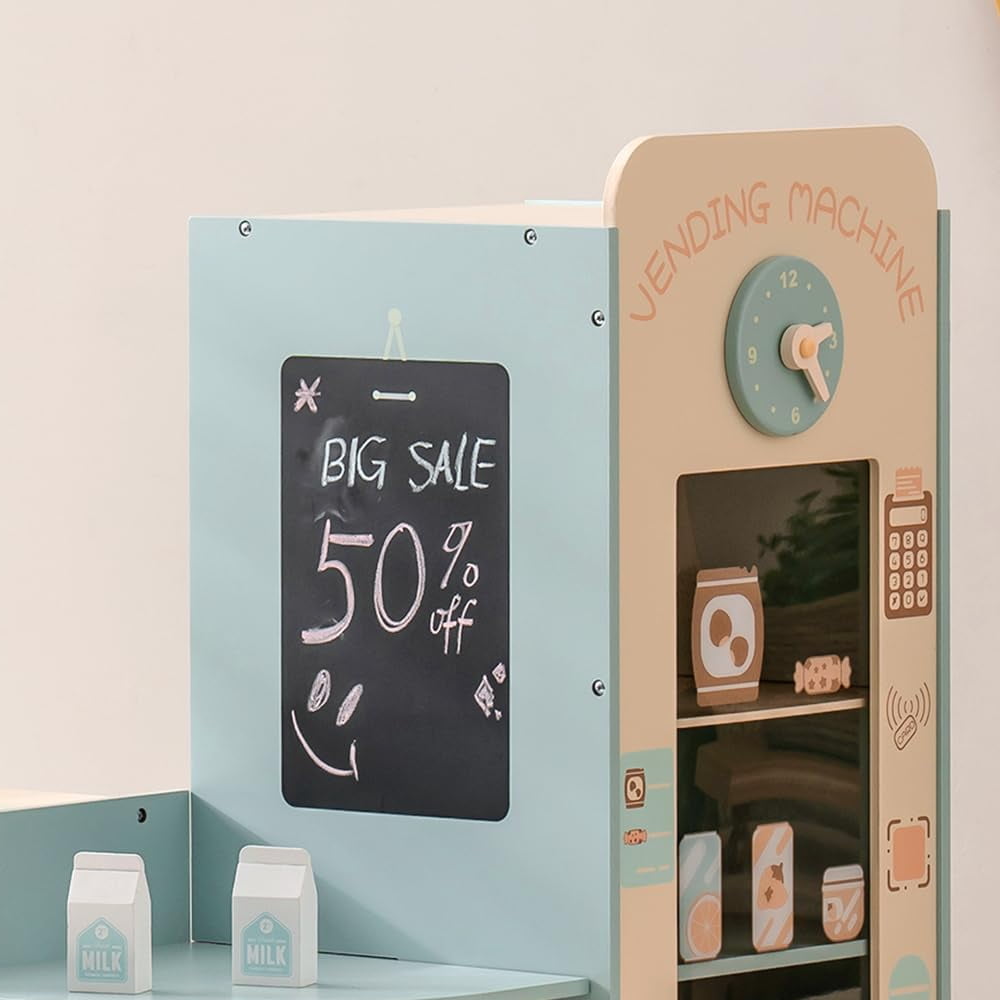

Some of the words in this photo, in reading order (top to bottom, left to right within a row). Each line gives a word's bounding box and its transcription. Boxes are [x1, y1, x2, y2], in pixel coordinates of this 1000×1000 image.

[630, 182, 771, 321] VENDING
[789, 182, 925, 323] MACHINE
[779, 270, 799, 289] 12
[748, 347, 758, 365] 9
[791, 406, 801, 424] 6
[321, 436, 387, 490] BIG
[409, 432, 496, 492] SALE
[430, 594, 477, 654] off
[82, 950, 122, 971] MILK
[246, 944, 287, 966] MILK
